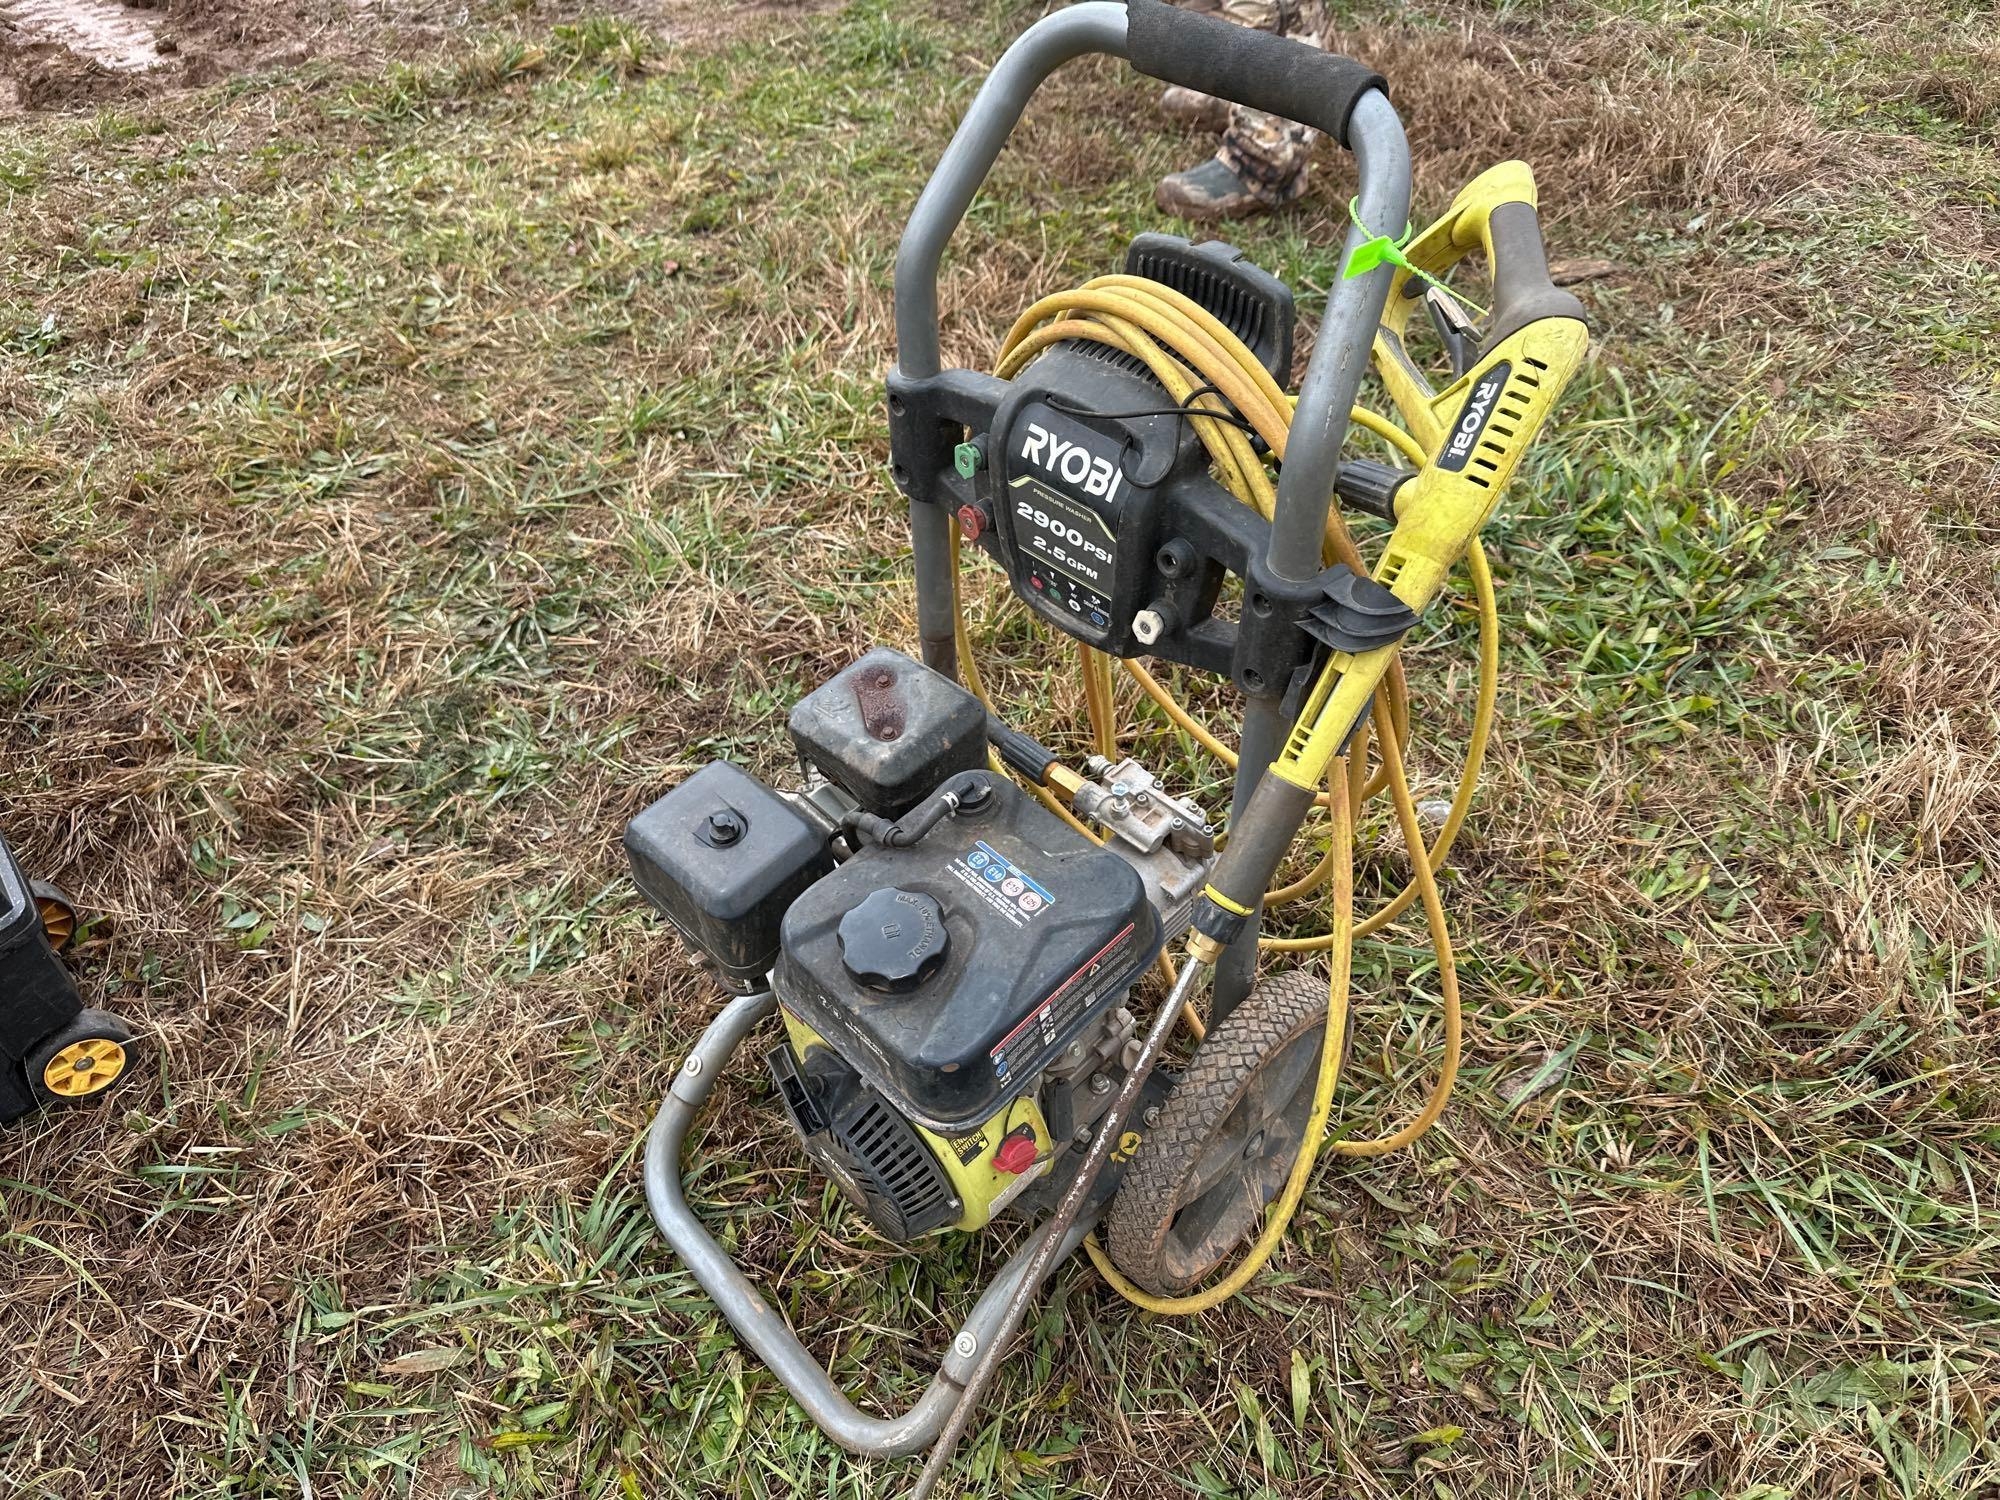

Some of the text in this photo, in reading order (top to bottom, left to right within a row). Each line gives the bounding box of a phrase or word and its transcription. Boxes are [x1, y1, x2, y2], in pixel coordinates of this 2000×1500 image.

[1450, 382, 1499, 456] RYOBI
[1021, 423, 1123, 503] RYOBI
[1033, 488, 1092, 523] PRESSURE WASHER
[957, 1131, 982, 1155] SWITCH
